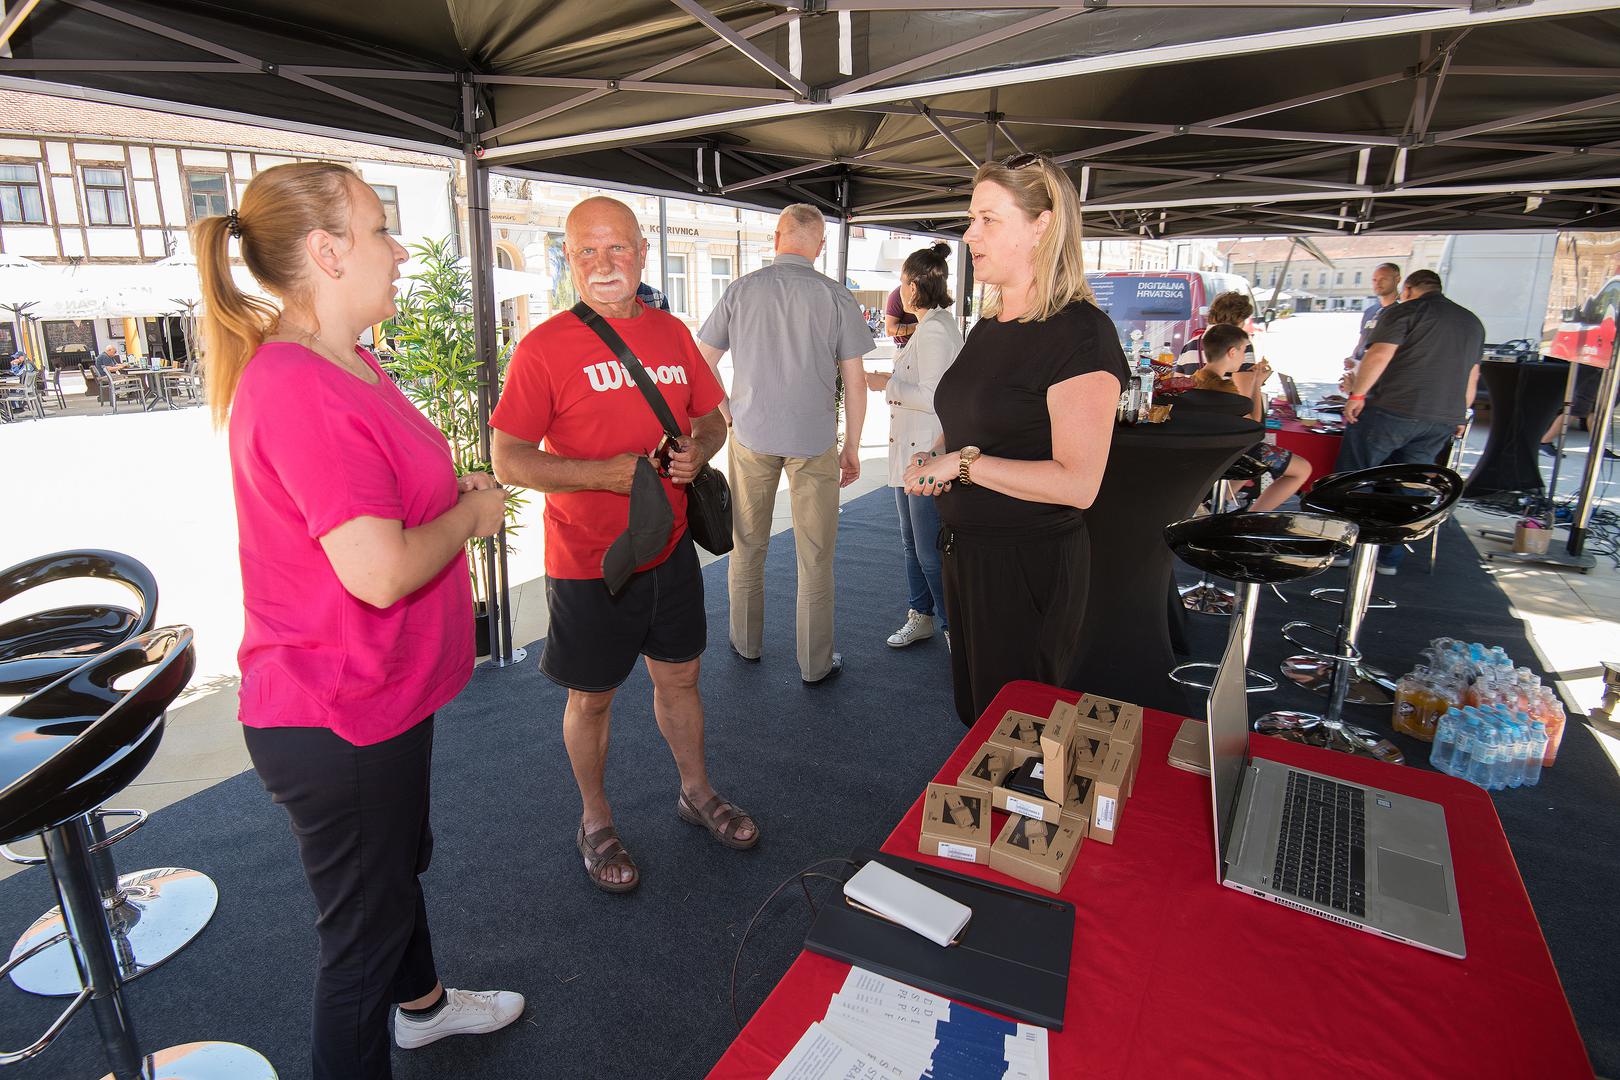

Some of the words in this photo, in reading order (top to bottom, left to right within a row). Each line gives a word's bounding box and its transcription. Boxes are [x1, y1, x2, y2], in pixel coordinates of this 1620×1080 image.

[650, 225, 699, 236] KORIVNICA
[1137, 282, 1185, 290] DIGITALNA
[1136, 290, 1184, 298] HRVATSKA
[583, 358, 688, 391] Wison
